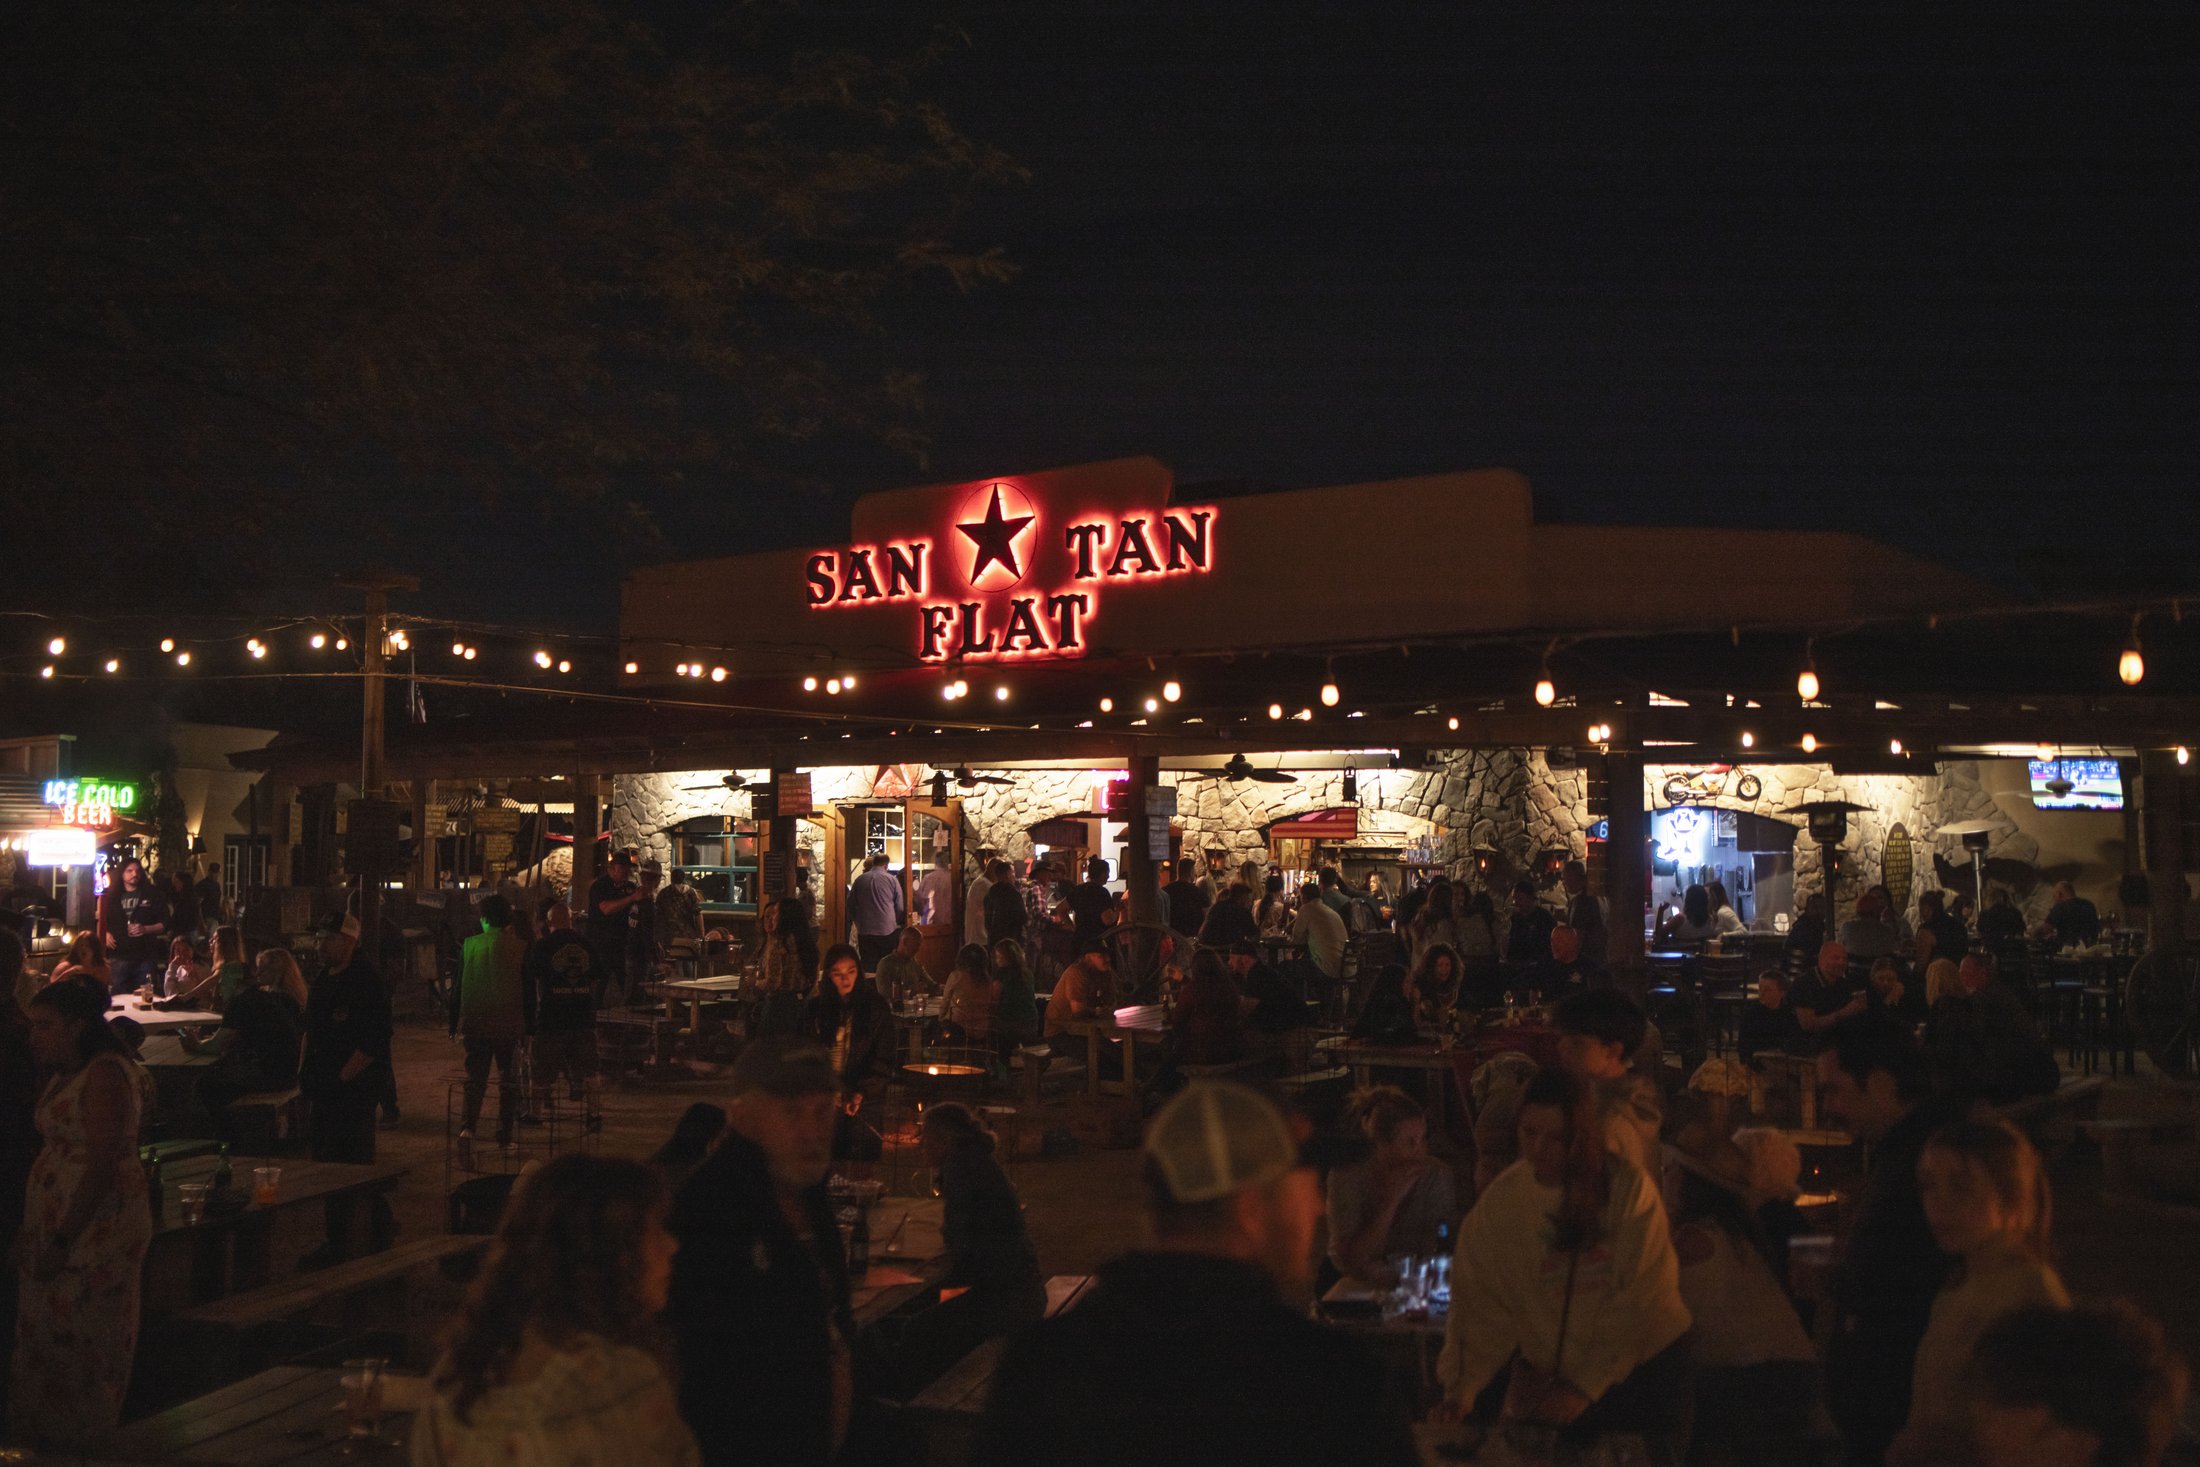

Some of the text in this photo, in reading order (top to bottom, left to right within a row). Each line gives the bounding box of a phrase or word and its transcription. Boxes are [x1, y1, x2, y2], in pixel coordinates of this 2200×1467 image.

[805, 511, 1212, 605] SAN TAN
[919, 593, 1088, 659] FLAT
[45, 780, 134, 808] ICE COLD
[63, 804, 112, 825] BEER
